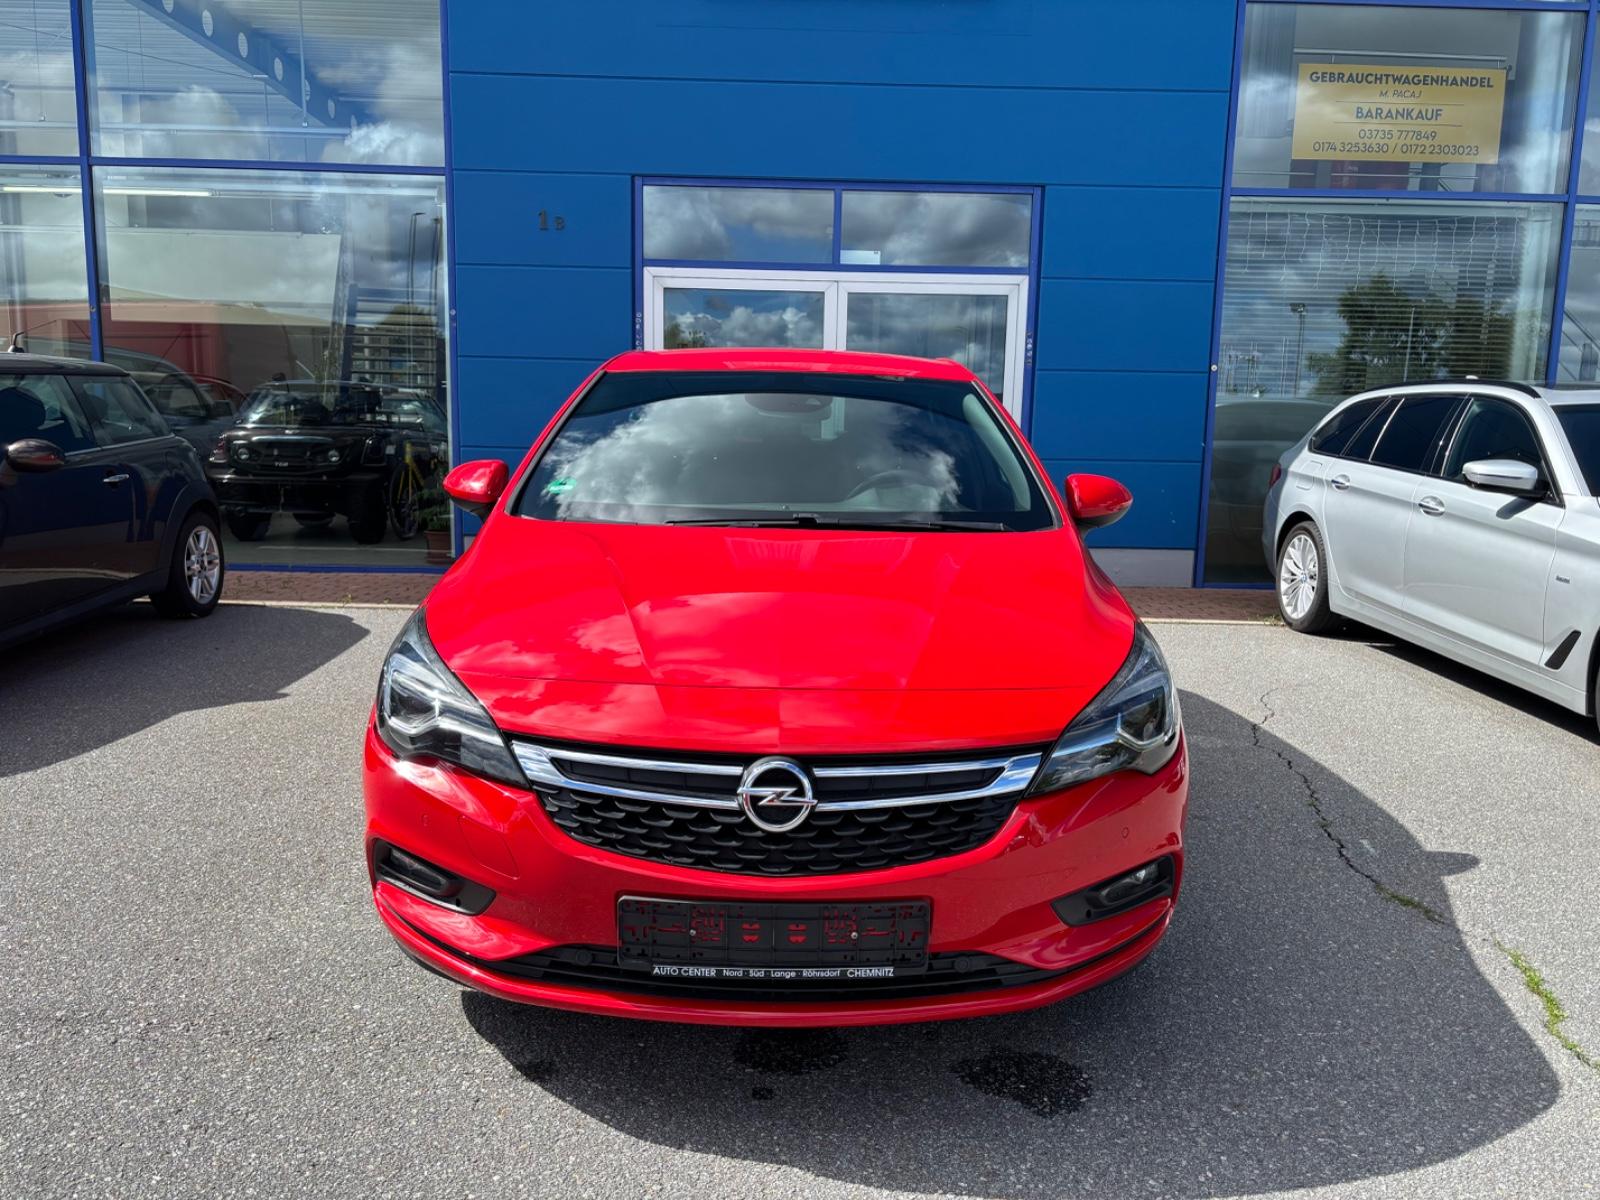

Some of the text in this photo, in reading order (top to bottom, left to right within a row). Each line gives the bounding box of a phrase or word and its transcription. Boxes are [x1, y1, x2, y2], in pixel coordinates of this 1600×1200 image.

[1309, 71, 1494, 88] GEBRAUCHTWAGENHANDEL
[1355, 107, 1443, 121] BARANKAUF
[1358, 129, 1437, 141] 03735 777849
[1312, 141, 1337, 153] 0174
[1339, 142, 1389, 154] 3253630
[1401, 143, 1426, 155] 0172
[1428, 145, 1479, 156] 2303023
[653, 966, 679, 975] AUTO
[681, 968, 717, 977] CENTER
[723, 969, 743, 977] Nord
[771, 970, 796, 979] Lange
[802, 969, 841, 978] Röhrsdorf
[847, 968, 894, 978] CHEMNITZ
